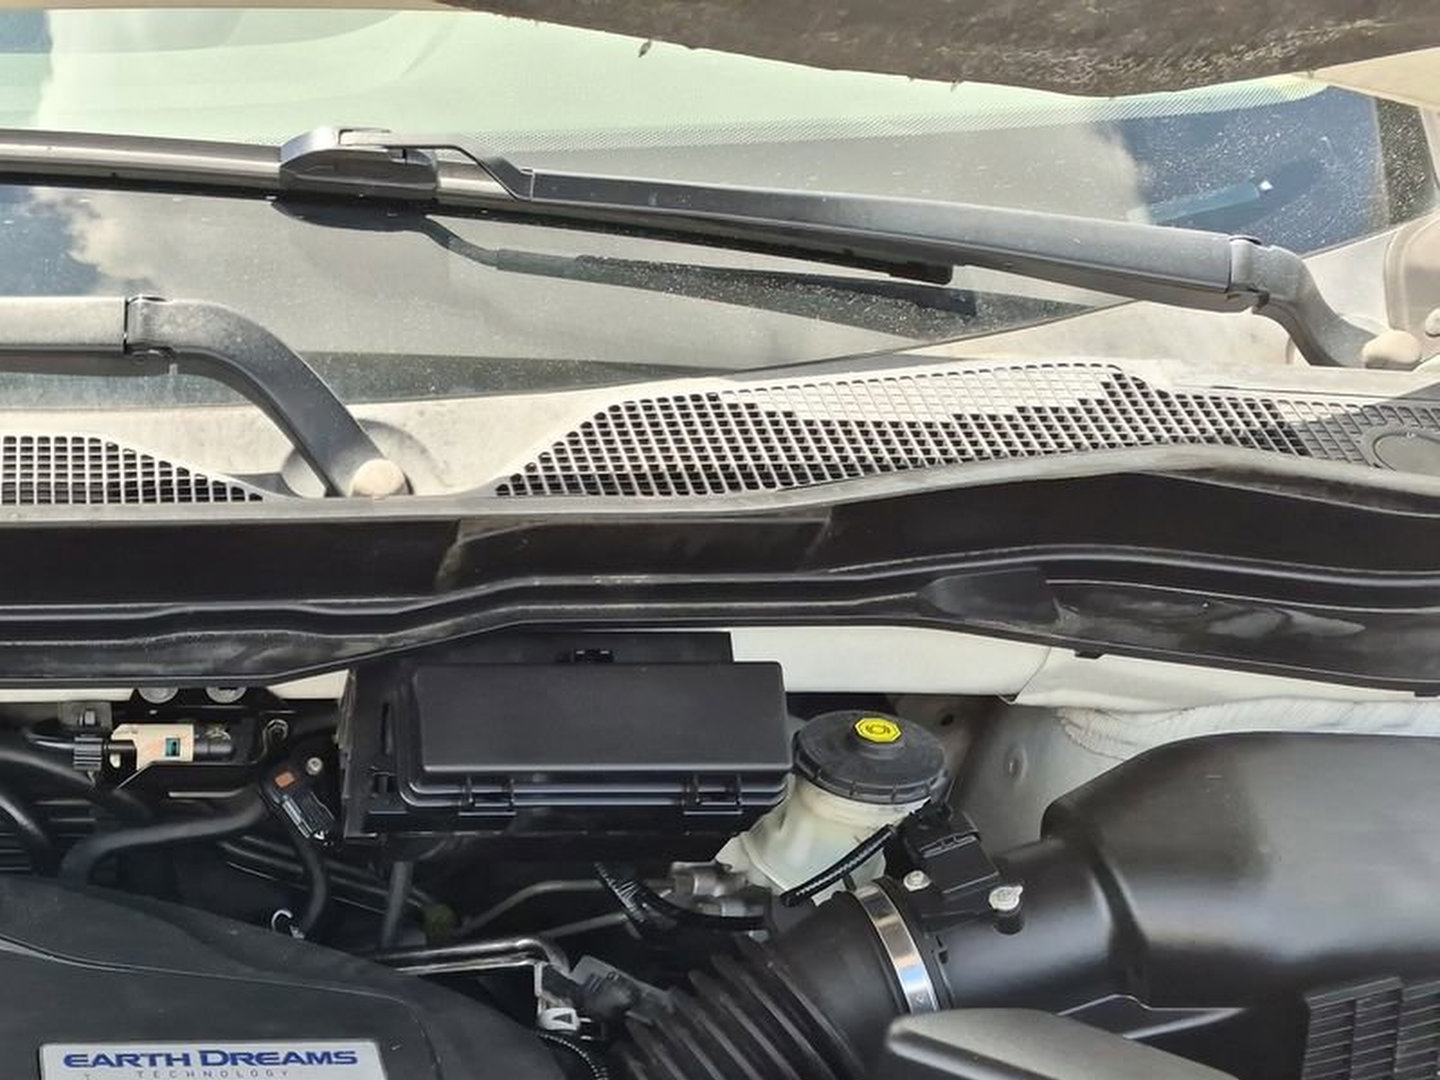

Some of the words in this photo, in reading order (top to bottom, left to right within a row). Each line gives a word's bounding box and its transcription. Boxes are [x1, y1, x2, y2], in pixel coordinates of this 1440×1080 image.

[63, 1052, 191, 1068] EARTH
[199, 1049, 358, 1067] DREAMS
[137, 1068, 289, 1079] TECHNOLOGY
